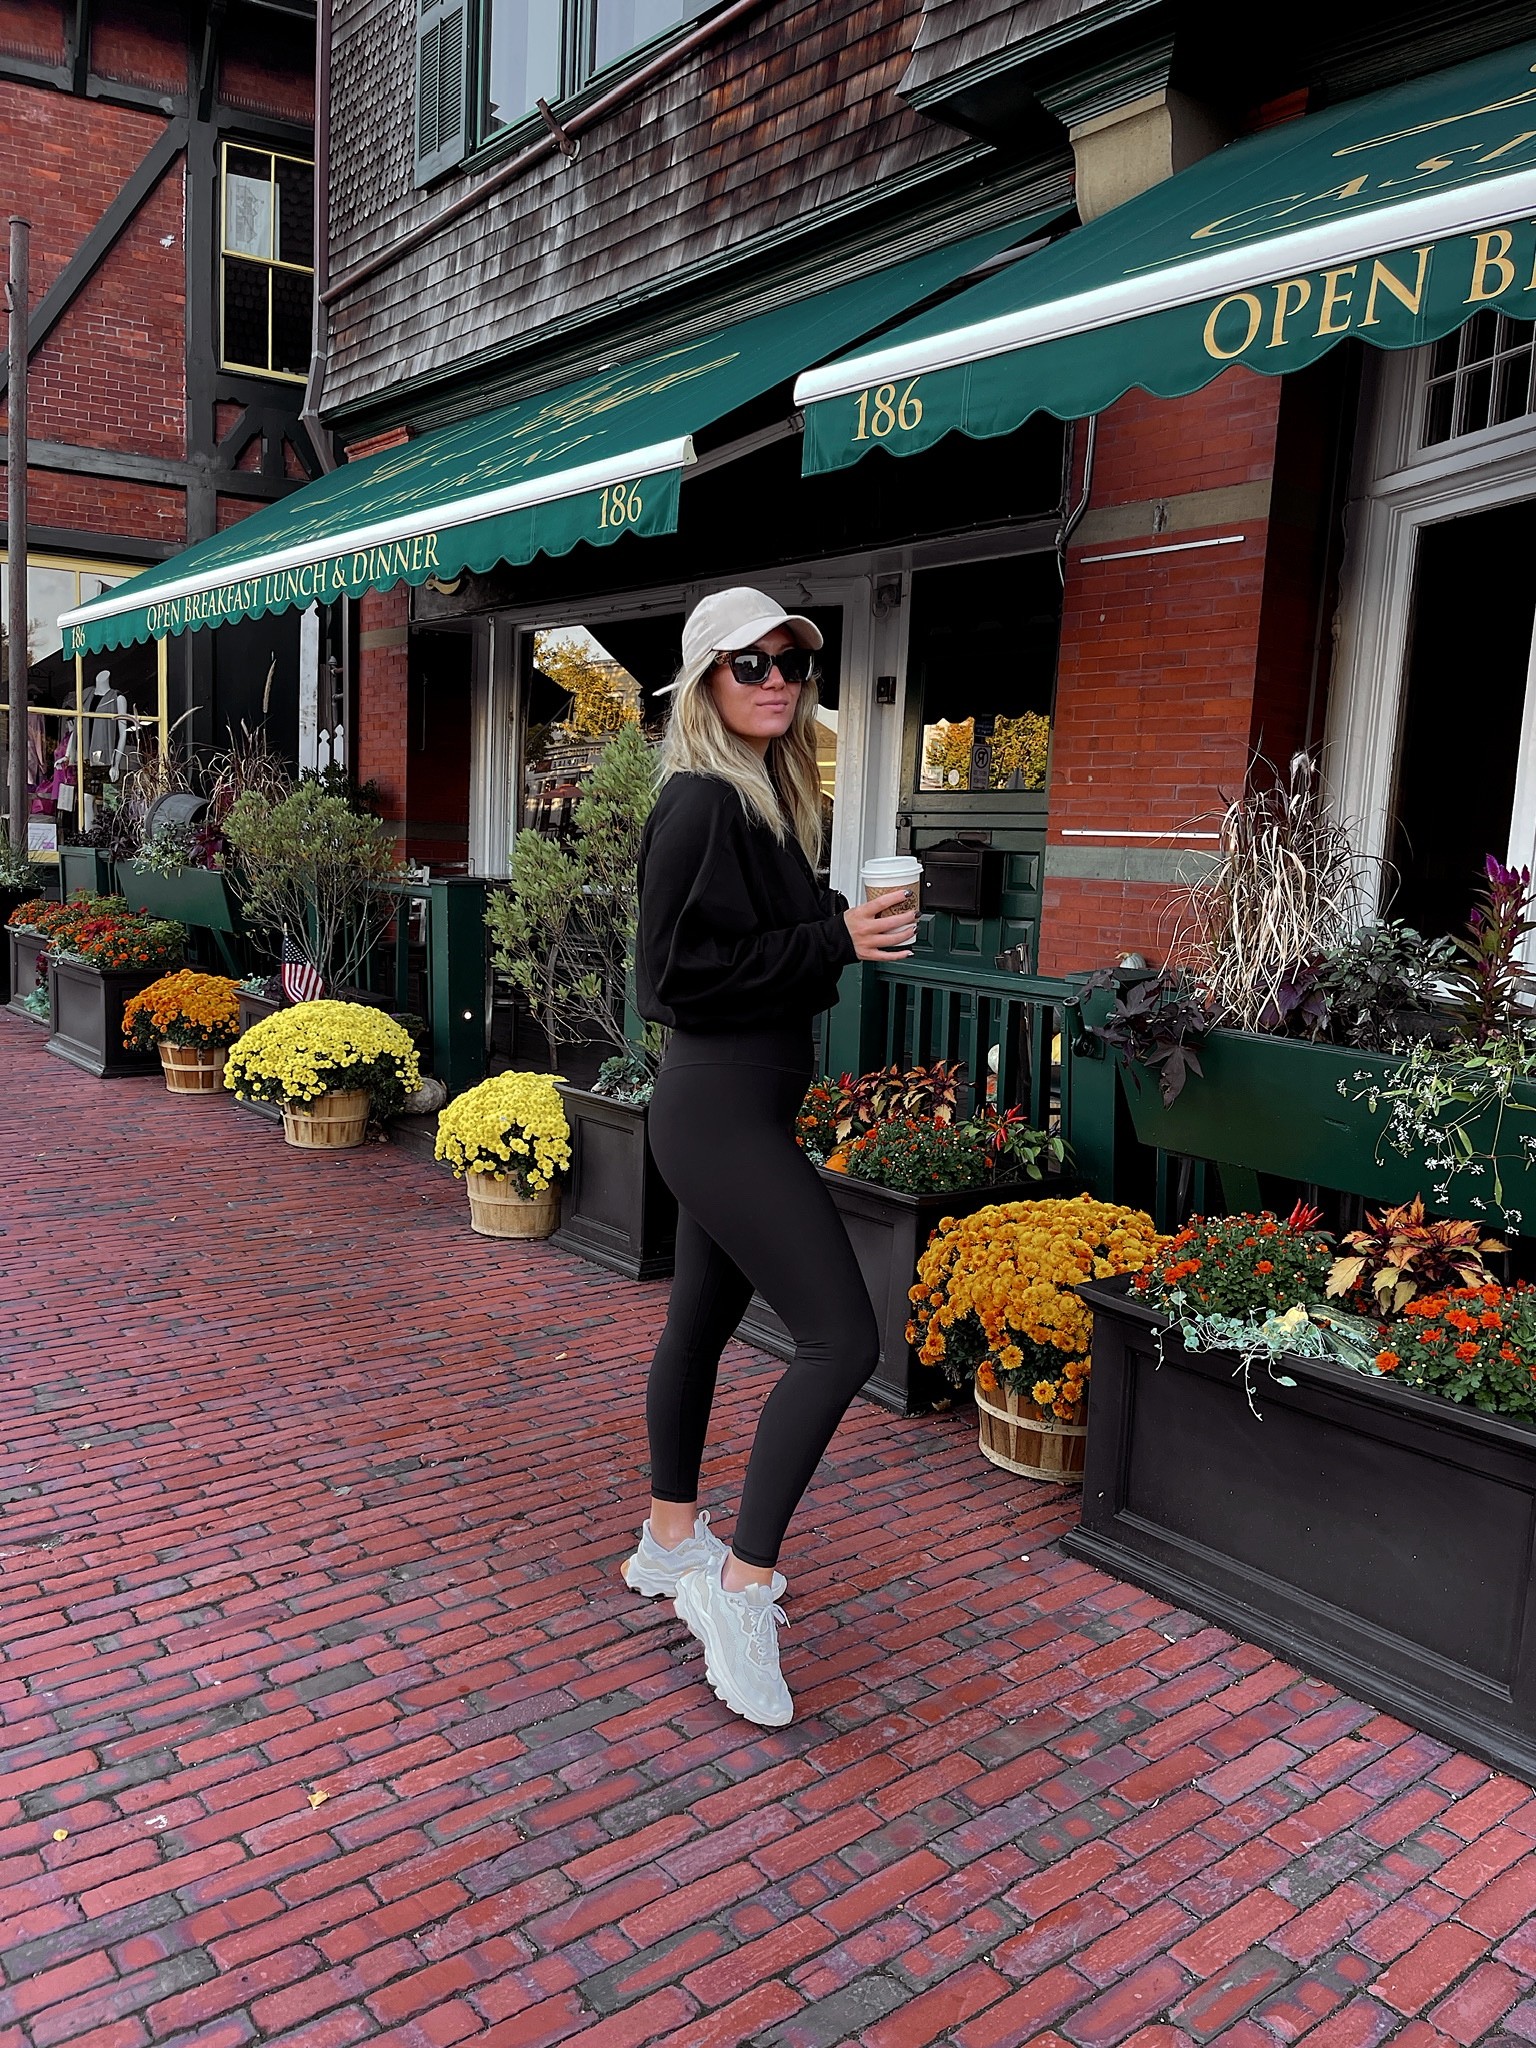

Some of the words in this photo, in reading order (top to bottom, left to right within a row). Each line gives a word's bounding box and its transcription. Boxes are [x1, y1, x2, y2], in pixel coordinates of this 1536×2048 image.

[1203, 245, 1434, 360] OPEN
[852, 376, 924, 441] 186
[597, 478, 643, 530] 186
[70, 625, 86, 650] 186
[146, 597, 180, 632] OPEN
[183, 577, 262, 624] BREAKFAST
[264, 560, 328, 608] LUNCH
[331, 557, 346, 589] &
[351, 532, 440, 586] DINNER
